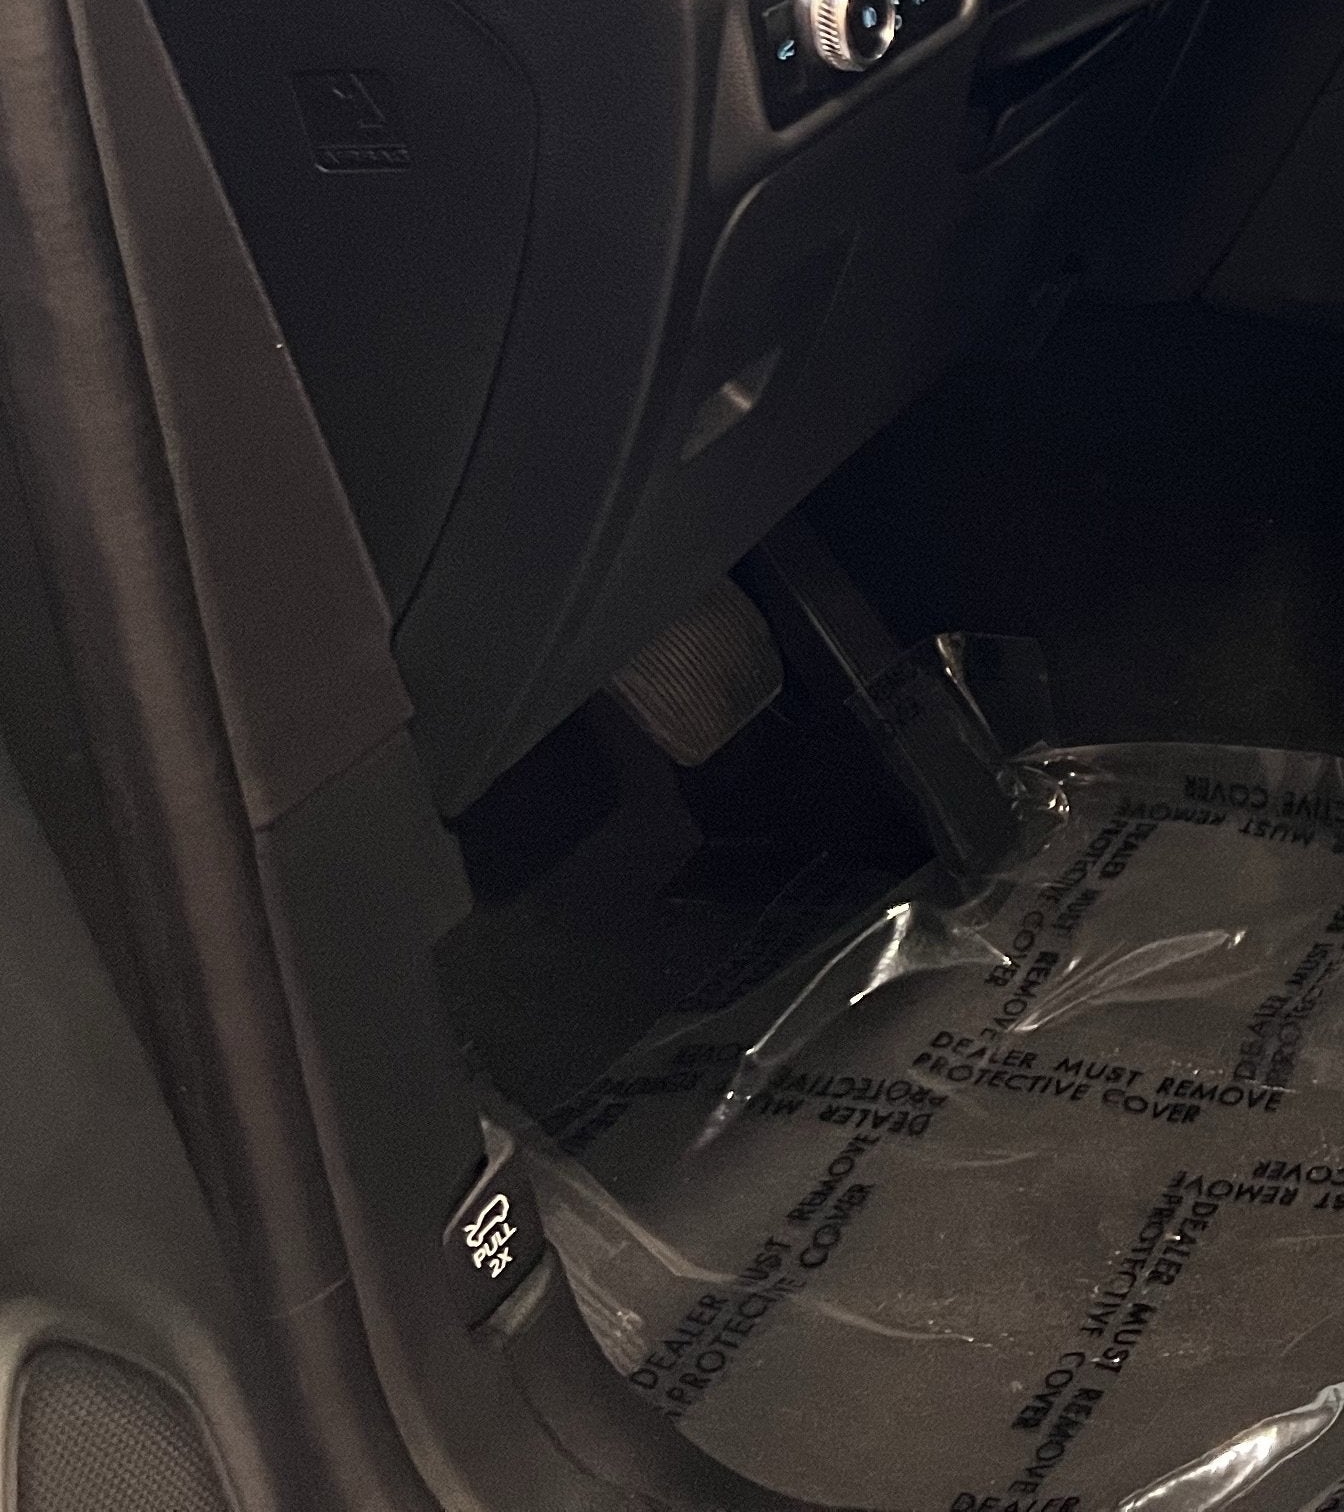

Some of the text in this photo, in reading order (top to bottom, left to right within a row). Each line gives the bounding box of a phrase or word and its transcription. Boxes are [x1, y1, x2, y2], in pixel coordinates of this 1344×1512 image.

[912, 1052, 1202, 1124] PROTECTIVE COVER
[928, 1030, 1285, 1113] DEALER MUST REMOVE
[819, 1105, 934, 1137] DEALER
[1170, 1170, 1297, 1208] REMOVE
[472, 1222, 518, 1269] PULL
[488, 1246, 515, 1279] 2X
[629, 1292, 728, 1391] DEALER
[787, 1131, 881, 1229] REMOVE
[798, 1182, 876, 1271] COVER
[1095, 1302, 1157, 1374] MUST
[1011, 1350, 1086, 1430] COVER
[1007, 1387, 1104, 1494] REMOVE
